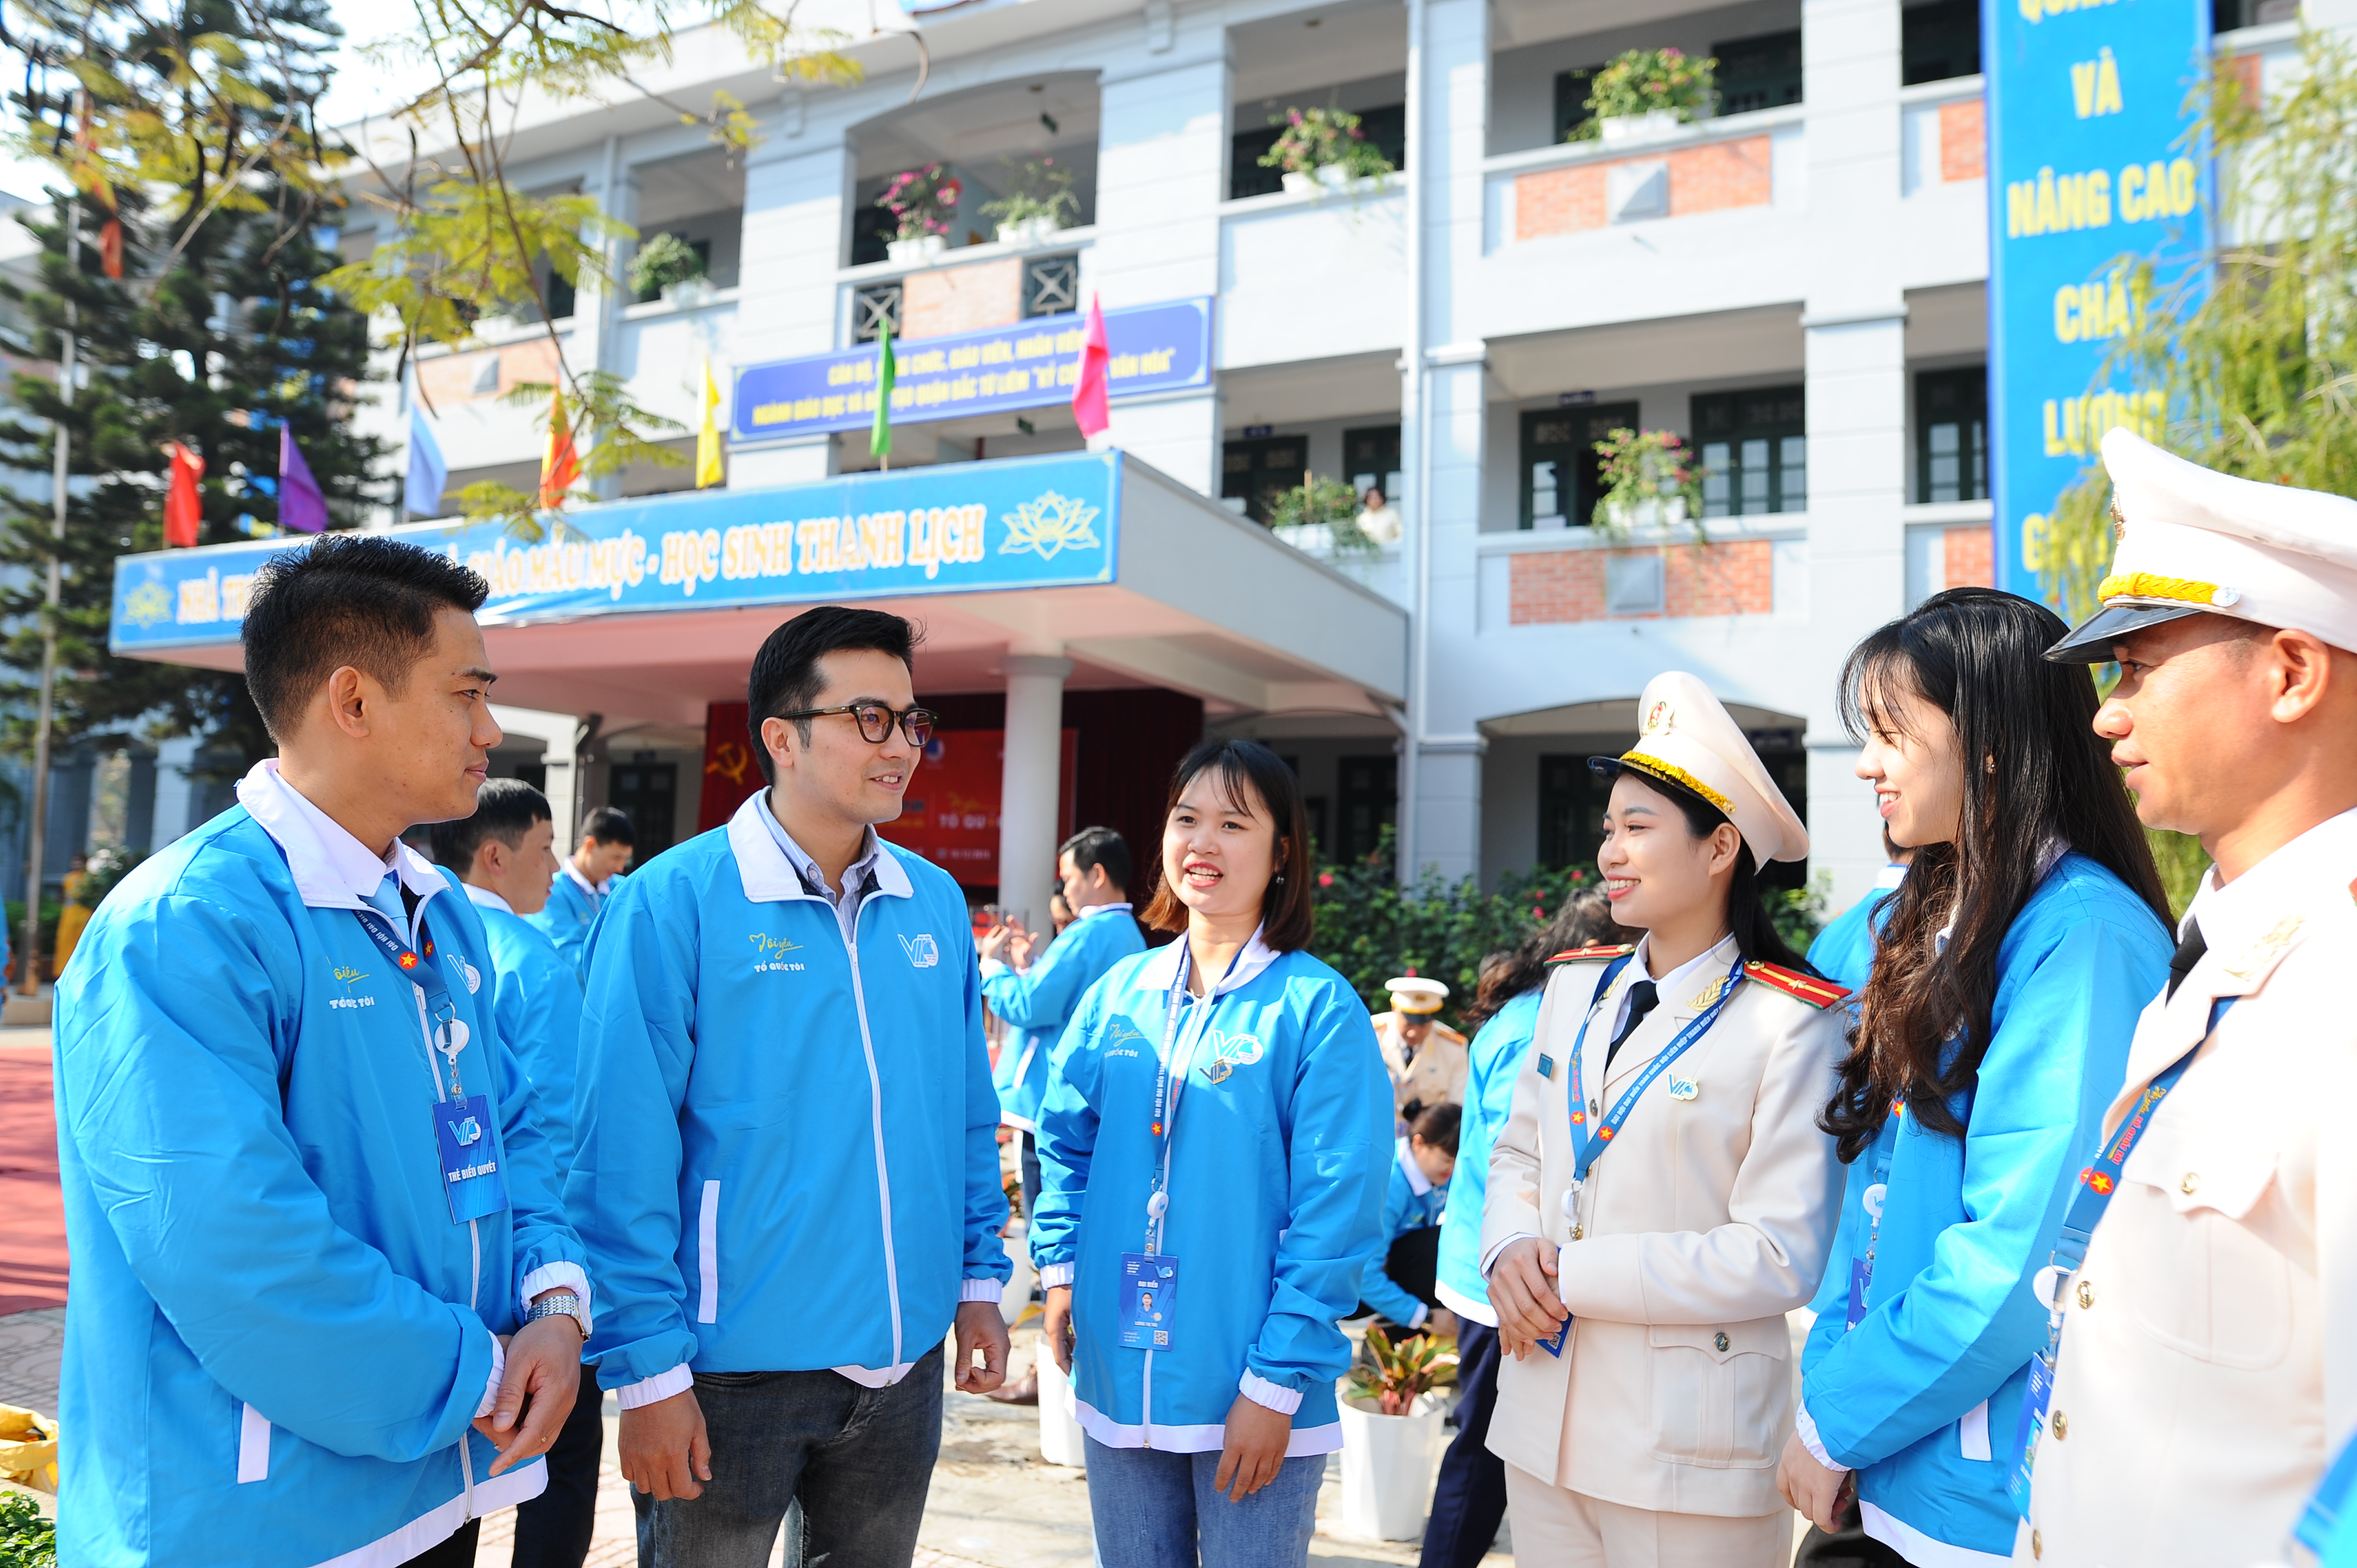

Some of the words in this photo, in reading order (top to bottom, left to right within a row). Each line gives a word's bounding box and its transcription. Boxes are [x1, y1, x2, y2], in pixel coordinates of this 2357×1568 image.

[2070, 45, 2123, 119] VÀ
[2008, 165, 2112, 239] NÂNG
[2119, 156, 2196, 224] CAO
[659, 527, 720, 597] HỌC
[722, 520, 794, 581] SINH
[796, 510, 905, 575] THANH
[906, 502, 987, 580] LỊCH
[789, 962, 805, 971] TÔI
[447, 1168, 461, 1183] THẺ
[461, 1164, 476, 1179] BIỂU
[477, 1159, 496, 1175] QUYẾT
